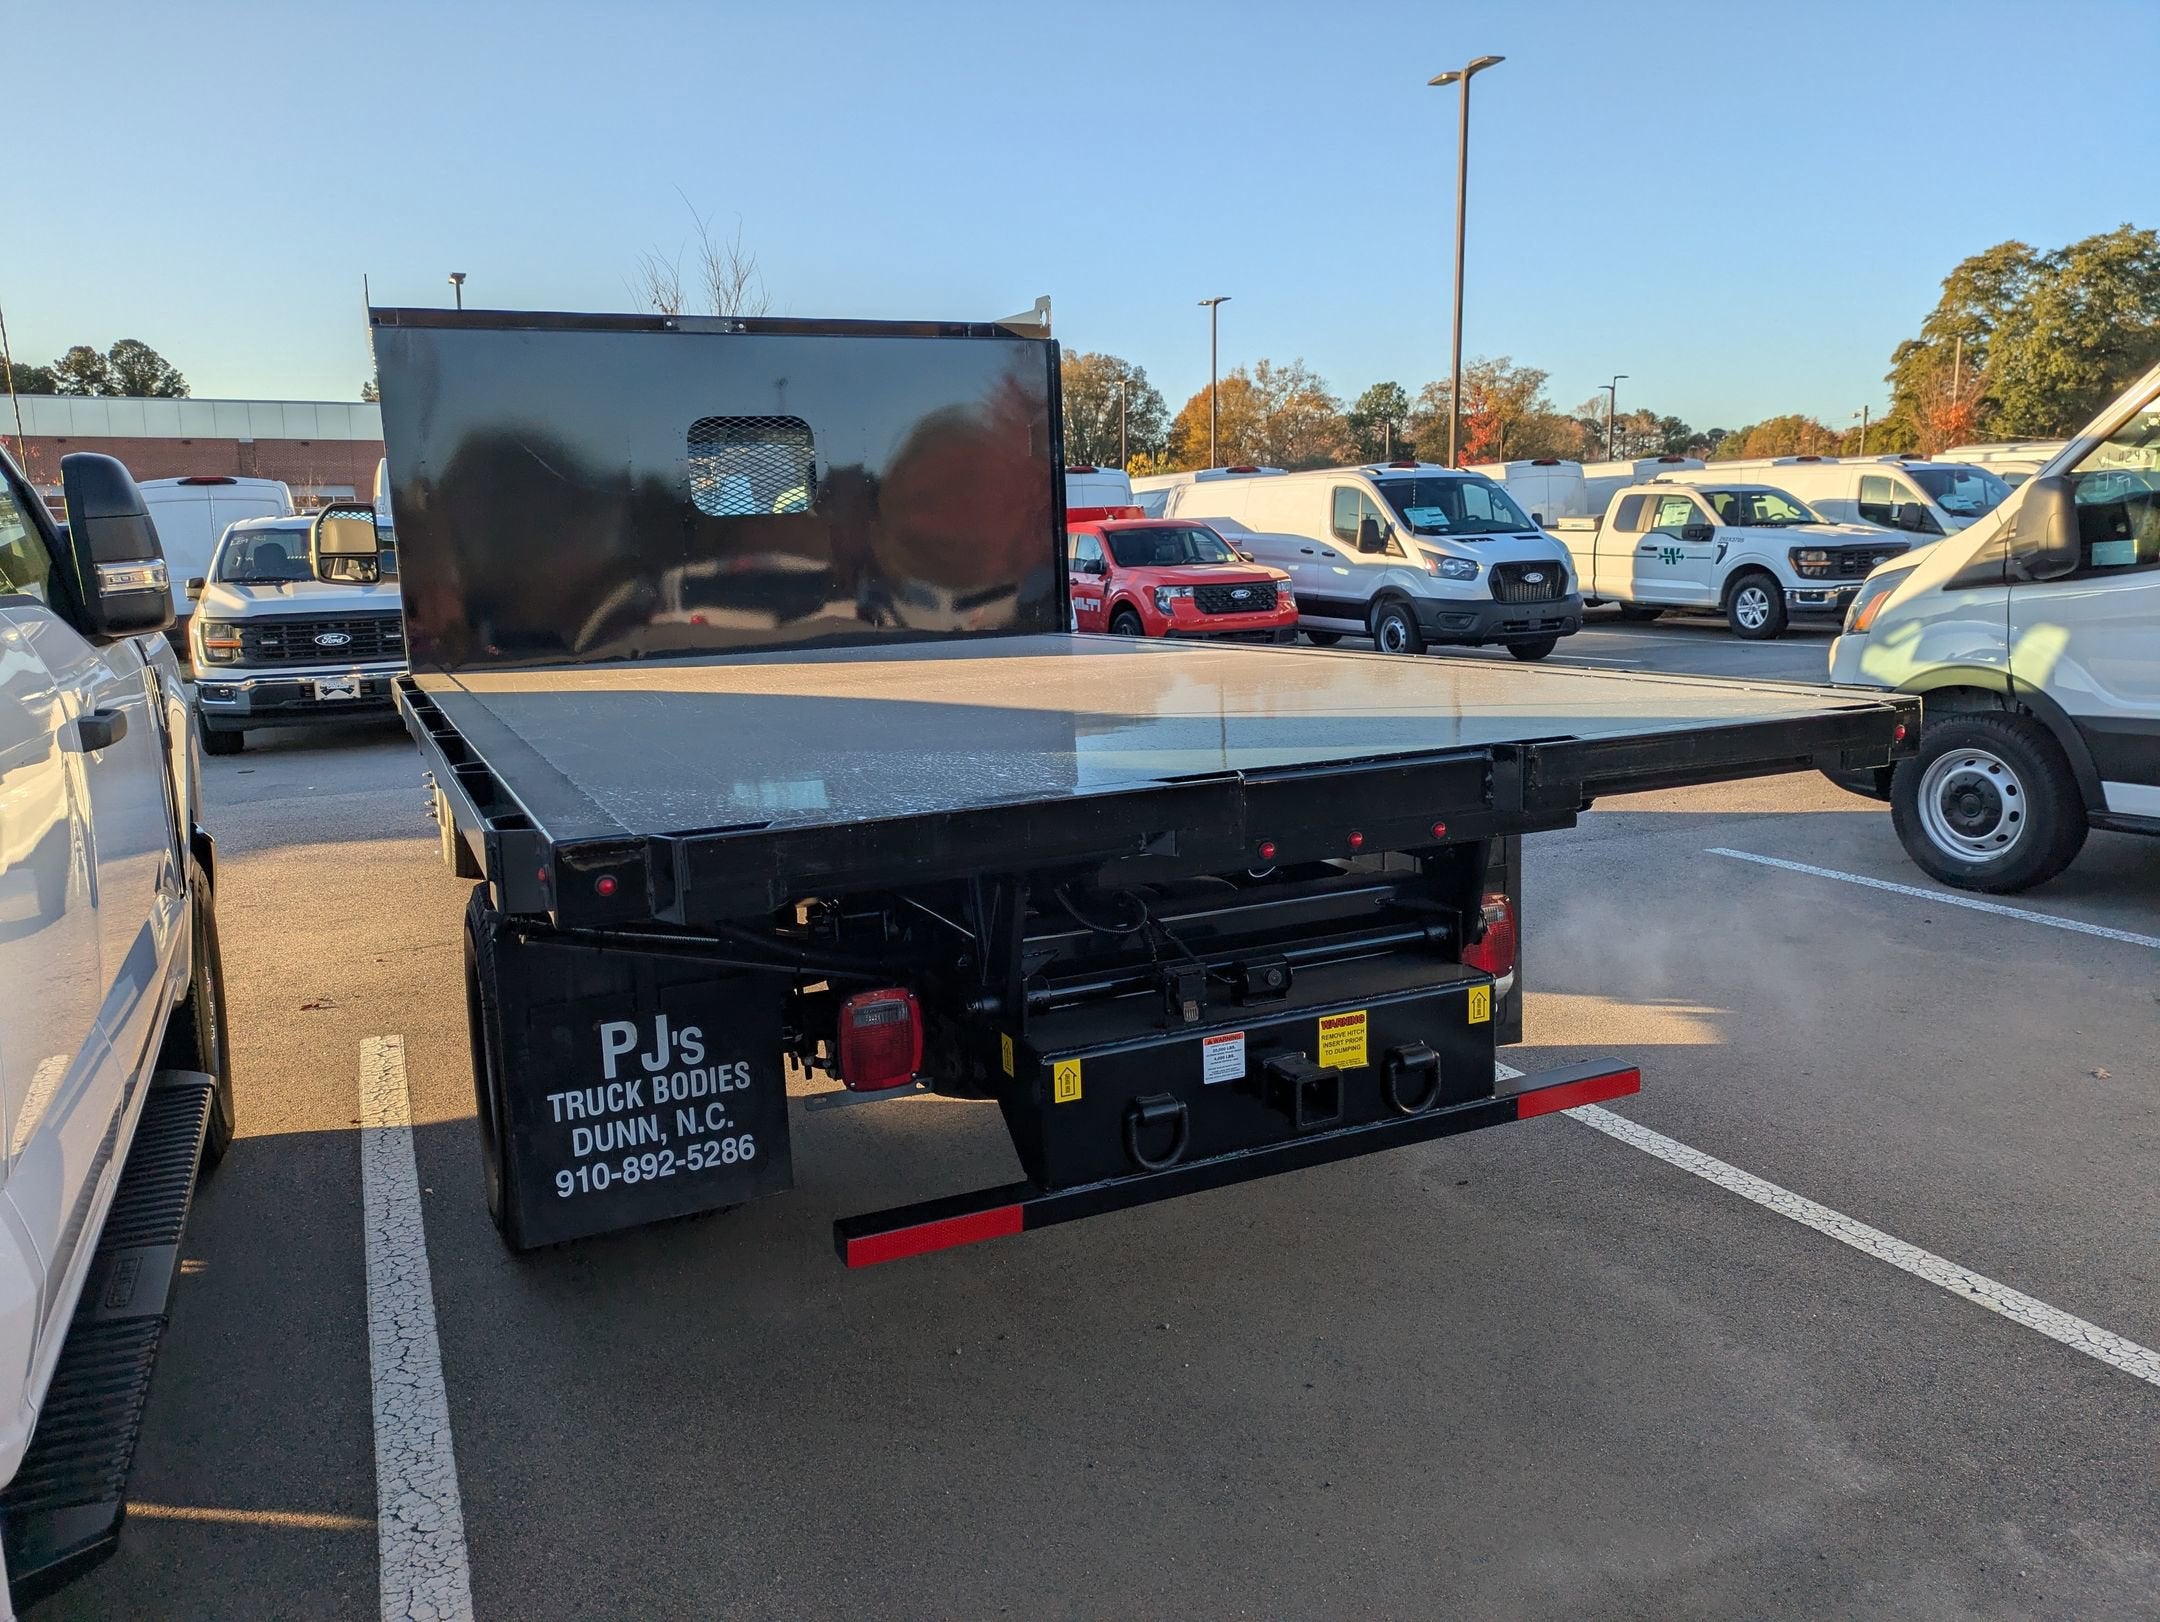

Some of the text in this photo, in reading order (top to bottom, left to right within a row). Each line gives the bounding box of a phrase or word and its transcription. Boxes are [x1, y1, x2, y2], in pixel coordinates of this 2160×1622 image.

[321, 634, 344, 644] Ford
[1320, 1014, 1365, 1030] WARNING
[1213, 1033, 1242, 1044] WARNING
[1321, 1028, 1365, 1041] REMOVE HITCH
[1322, 1036, 1364, 1049] INSERT PRIOR
[1334, 1044, 1361, 1055] DUMPING
[546, 1061, 751, 1123] TRUCK BODIES
[572, 1102, 734, 1157] DUNN, N.C.
[555, 1134, 756, 1198] 910-892-5286
